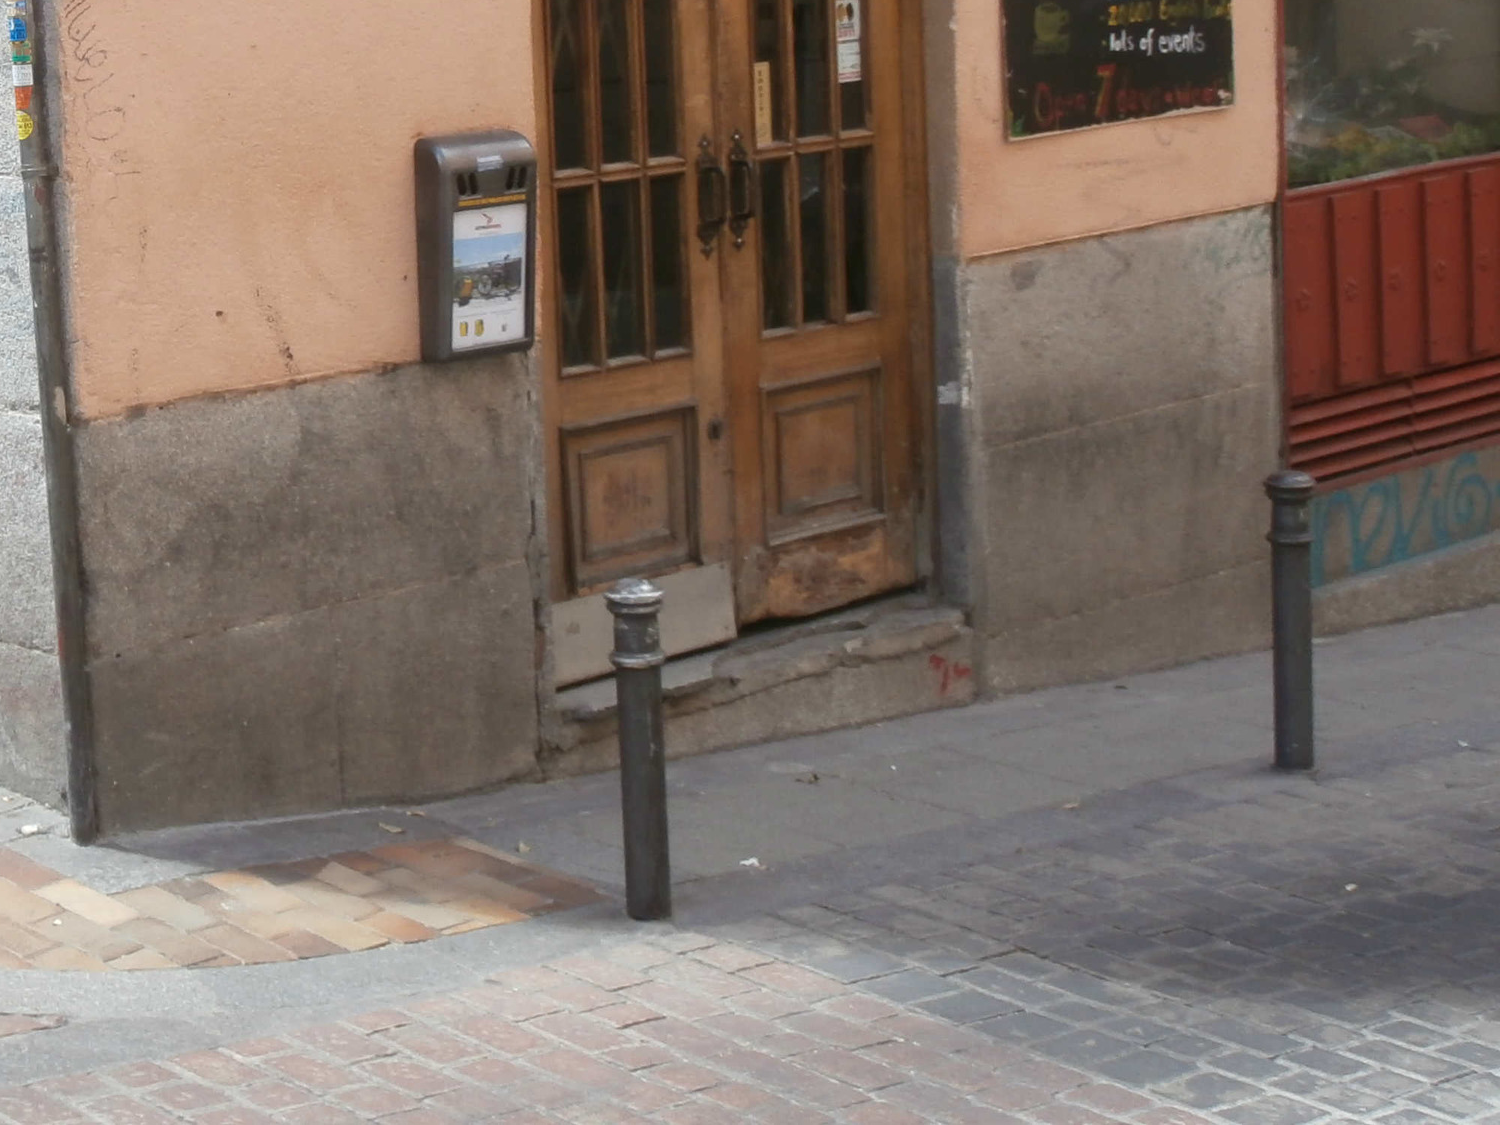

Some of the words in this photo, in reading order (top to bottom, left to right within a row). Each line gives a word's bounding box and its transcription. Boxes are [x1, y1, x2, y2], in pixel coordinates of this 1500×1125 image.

[1108, 31, 1135, 53] lots
[1139, 27, 1156, 57] of
[1158, 24, 1206, 54] events
